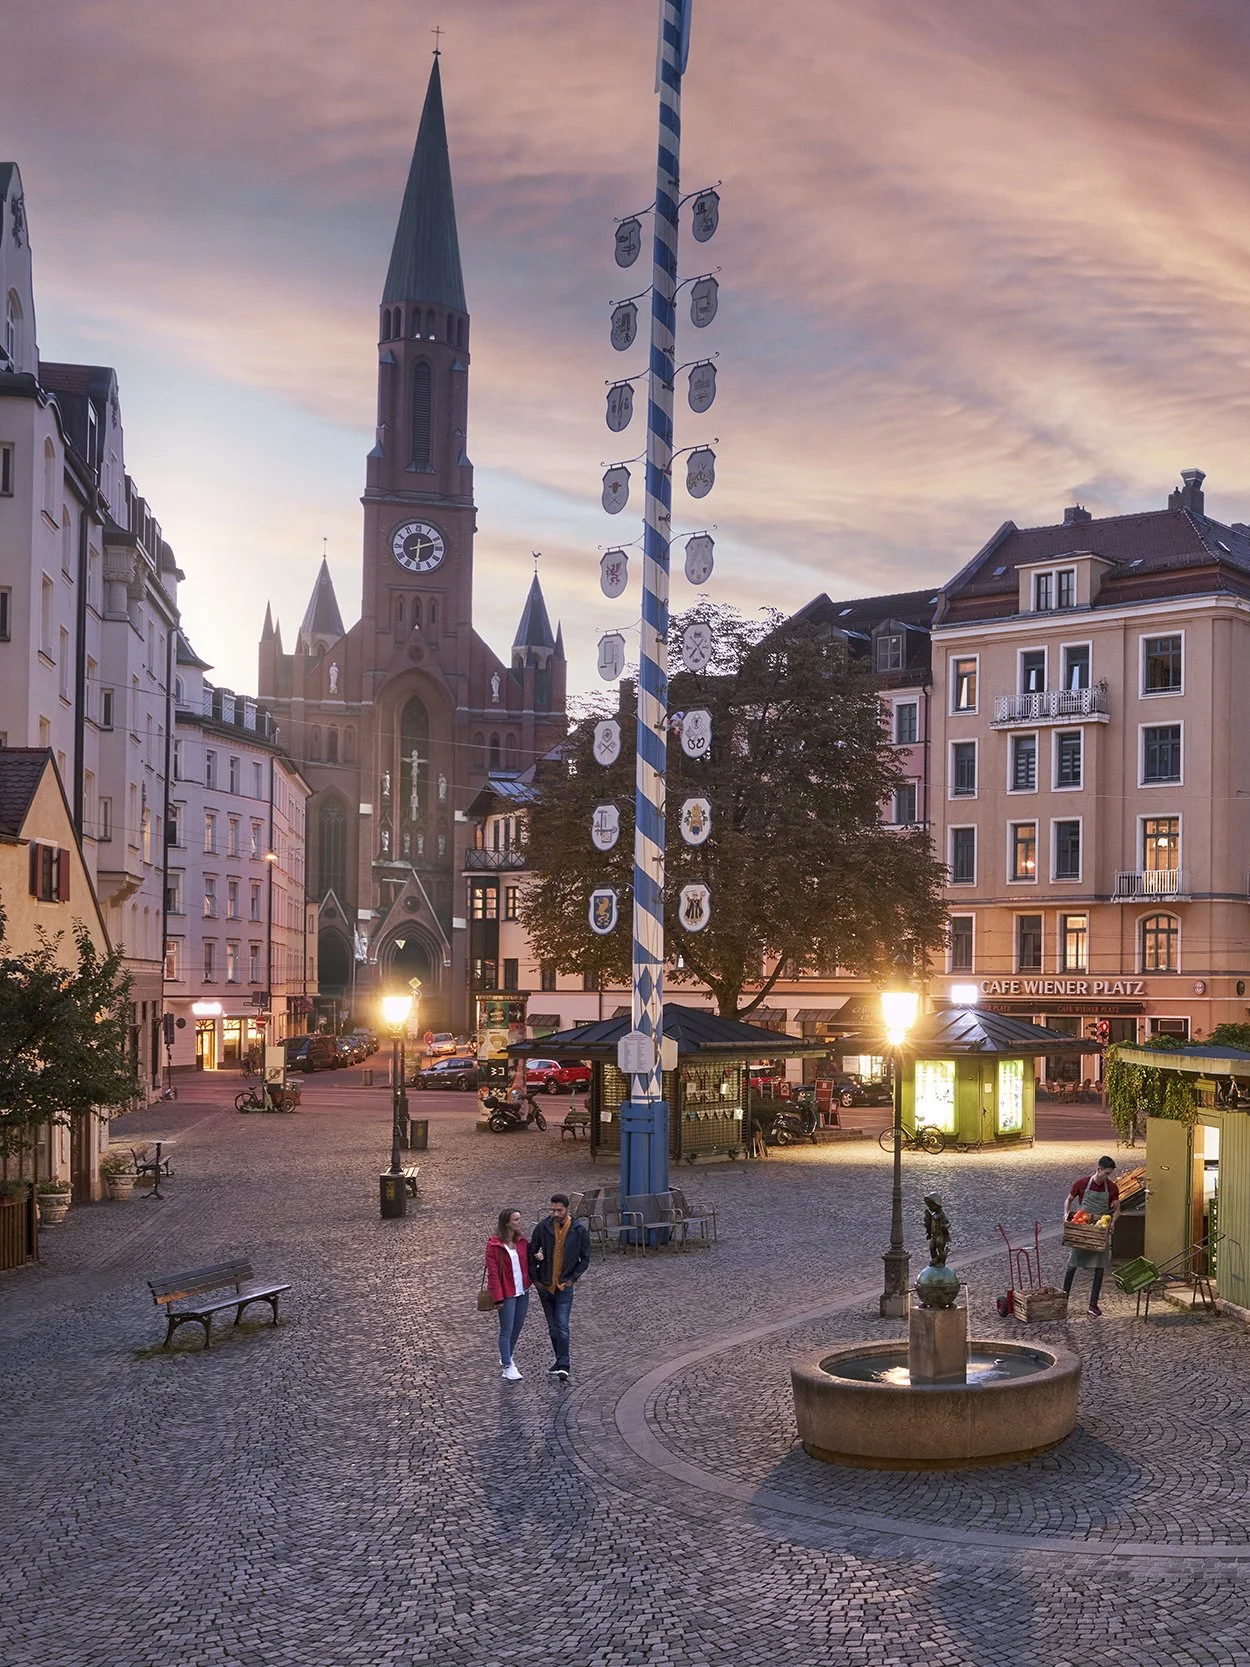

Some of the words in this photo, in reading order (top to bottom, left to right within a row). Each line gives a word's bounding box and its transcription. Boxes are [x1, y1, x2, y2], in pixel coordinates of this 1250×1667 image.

[980, 980, 1020, 994] CAFE
[1024, 981, 1088, 995] WIENER
[1093, 981, 1145, 995] PLATZ
